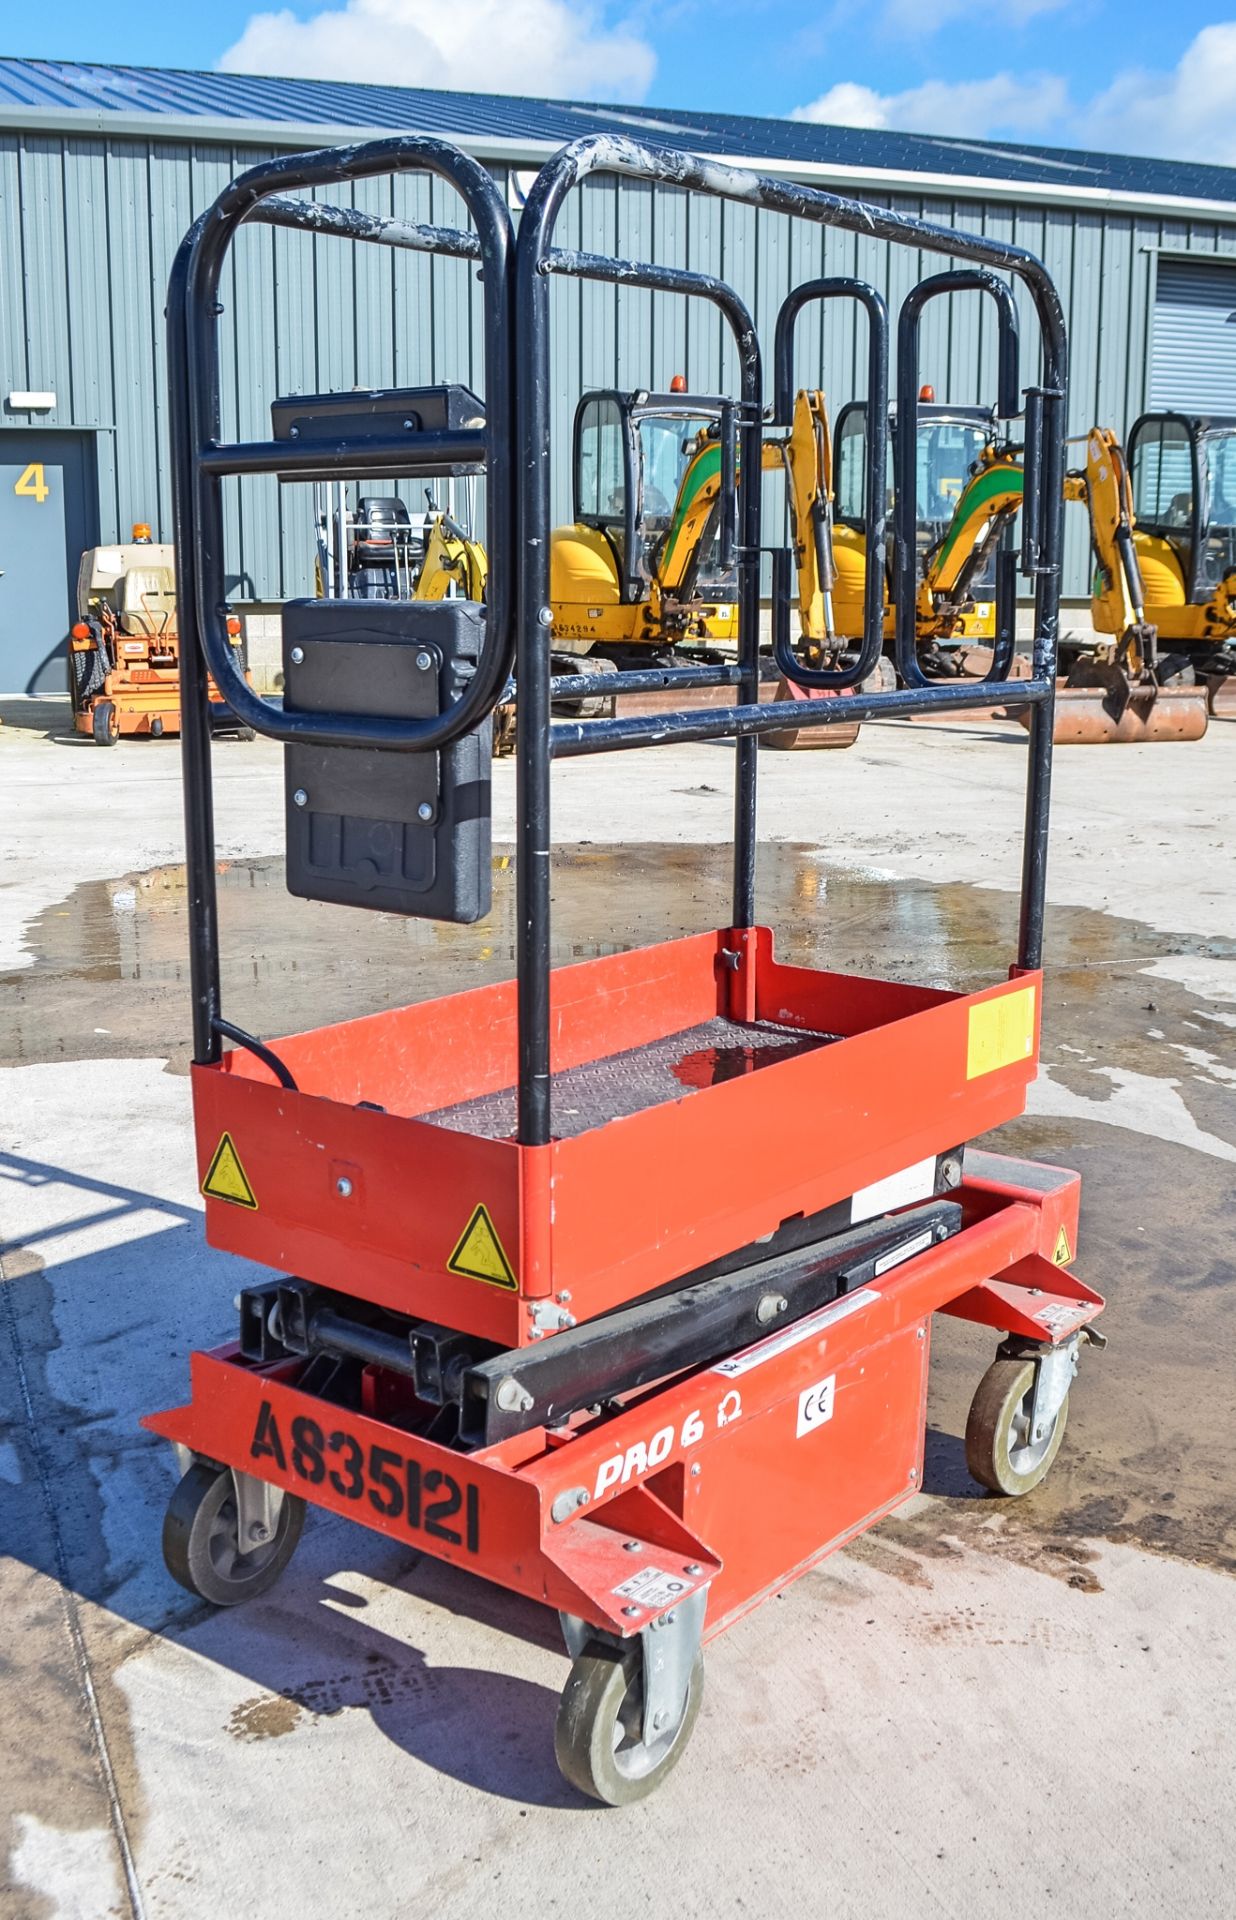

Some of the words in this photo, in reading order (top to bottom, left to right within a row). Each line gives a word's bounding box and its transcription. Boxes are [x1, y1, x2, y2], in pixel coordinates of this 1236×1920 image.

[14, 462, 49, 502] 4
[250, 1400, 479, 1554] A835121
[593, 1425, 675, 1500] PRO
[680, 1409, 705, 1448] 6
